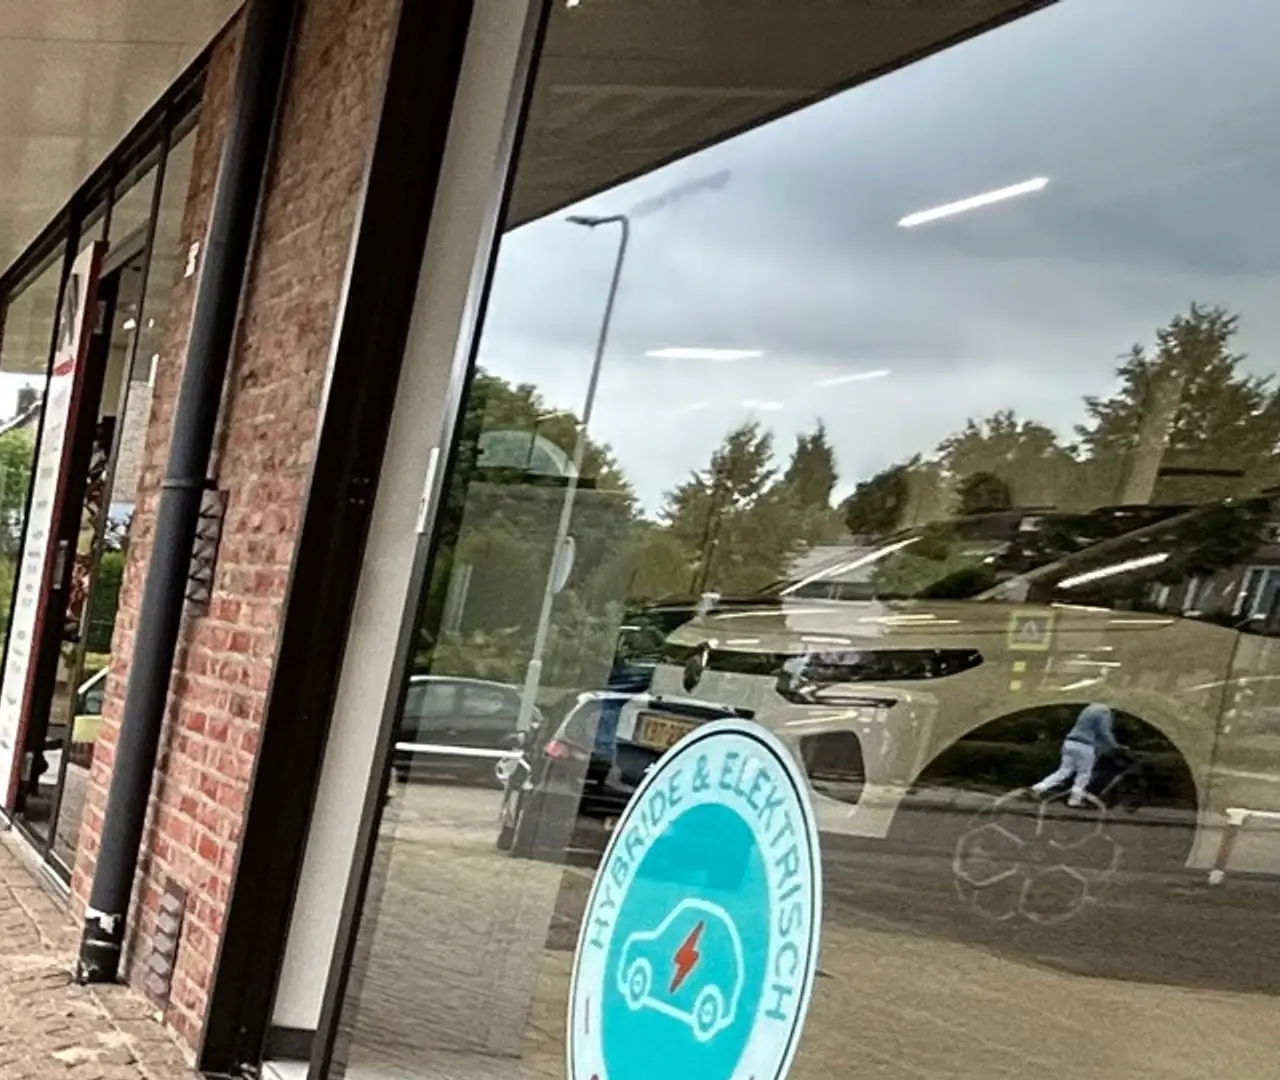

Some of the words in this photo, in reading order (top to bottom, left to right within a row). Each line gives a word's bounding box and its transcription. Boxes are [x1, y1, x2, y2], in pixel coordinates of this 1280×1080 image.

[590, 769, 684, 949] HYBRIDE
[692, 754, 710, 793] &
[717, 752, 802, 1022] ELEKTRISCH
